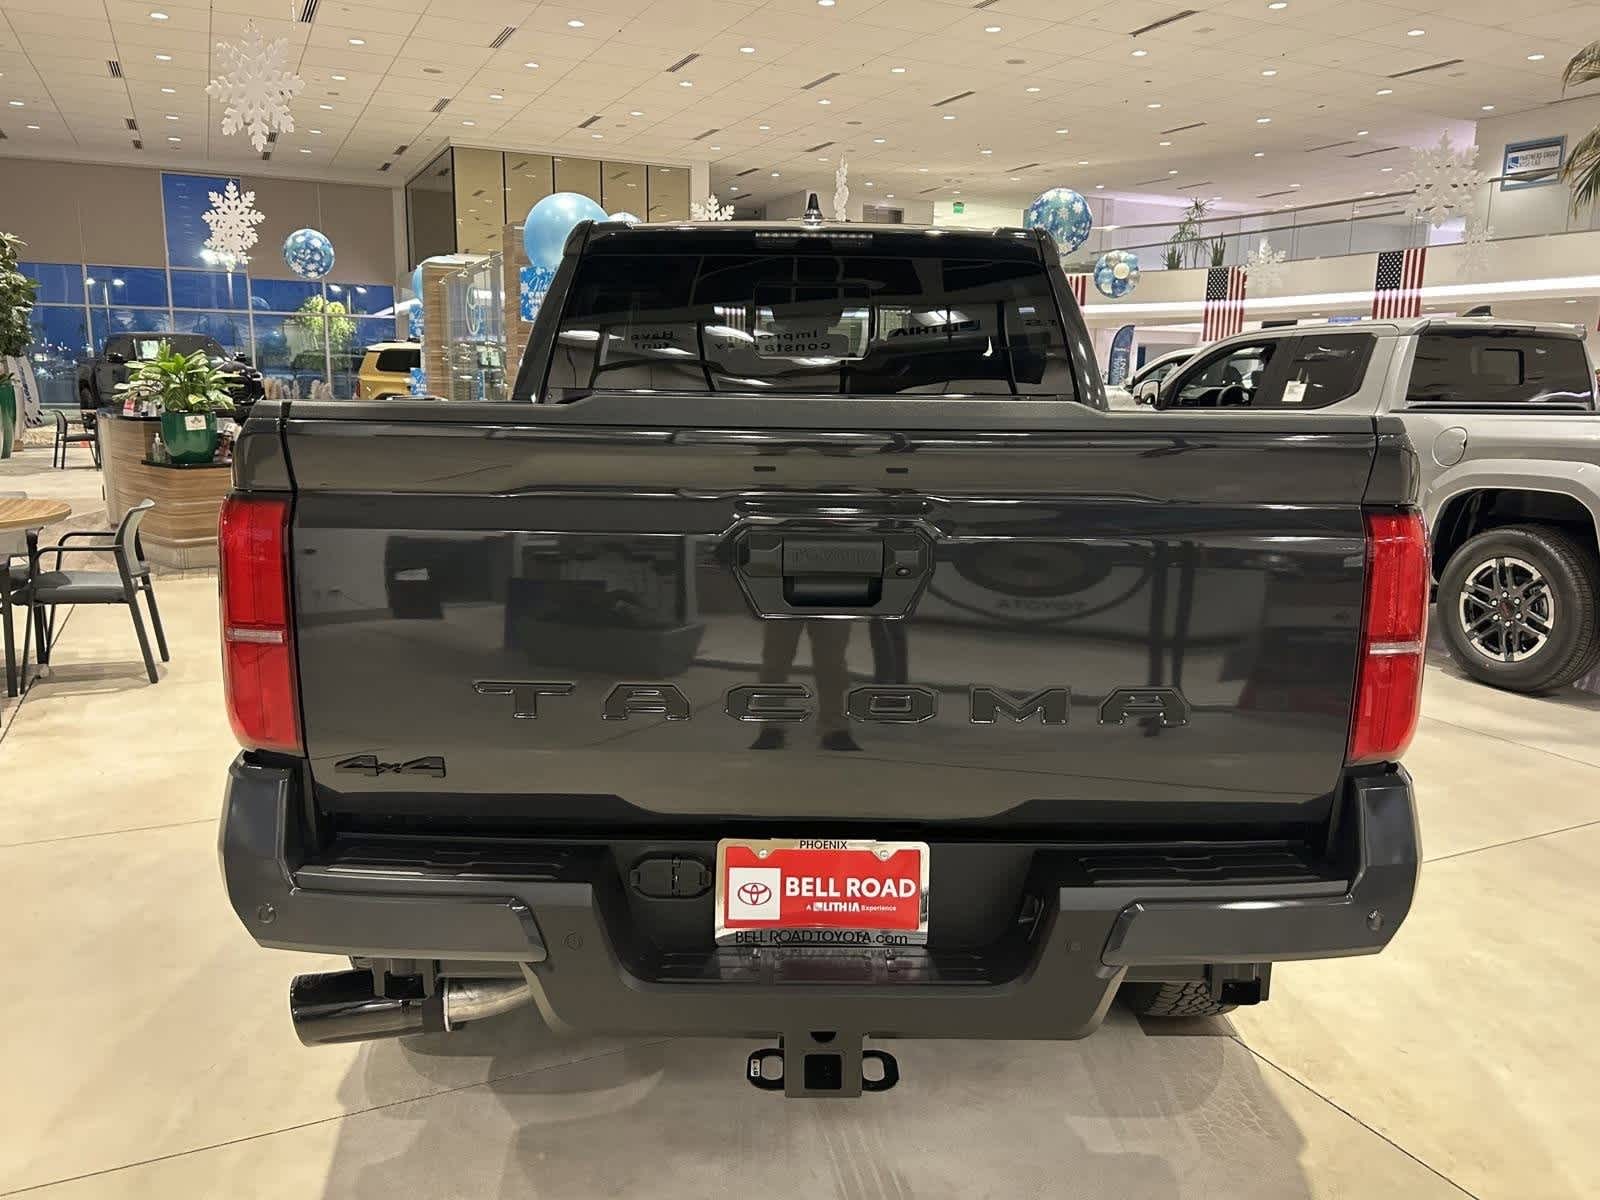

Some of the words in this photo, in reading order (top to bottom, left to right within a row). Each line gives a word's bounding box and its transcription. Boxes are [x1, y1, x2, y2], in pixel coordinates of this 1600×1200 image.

[473, 680, 1190, 725] TACOMA
[800, 840, 847, 850] PHOENIX
[785, 877, 840, 897] BELL
[846, 878, 916, 898] ROAD
[824, 902, 860, 912] LITHIA
[861, 905, 897, 913] Experience
